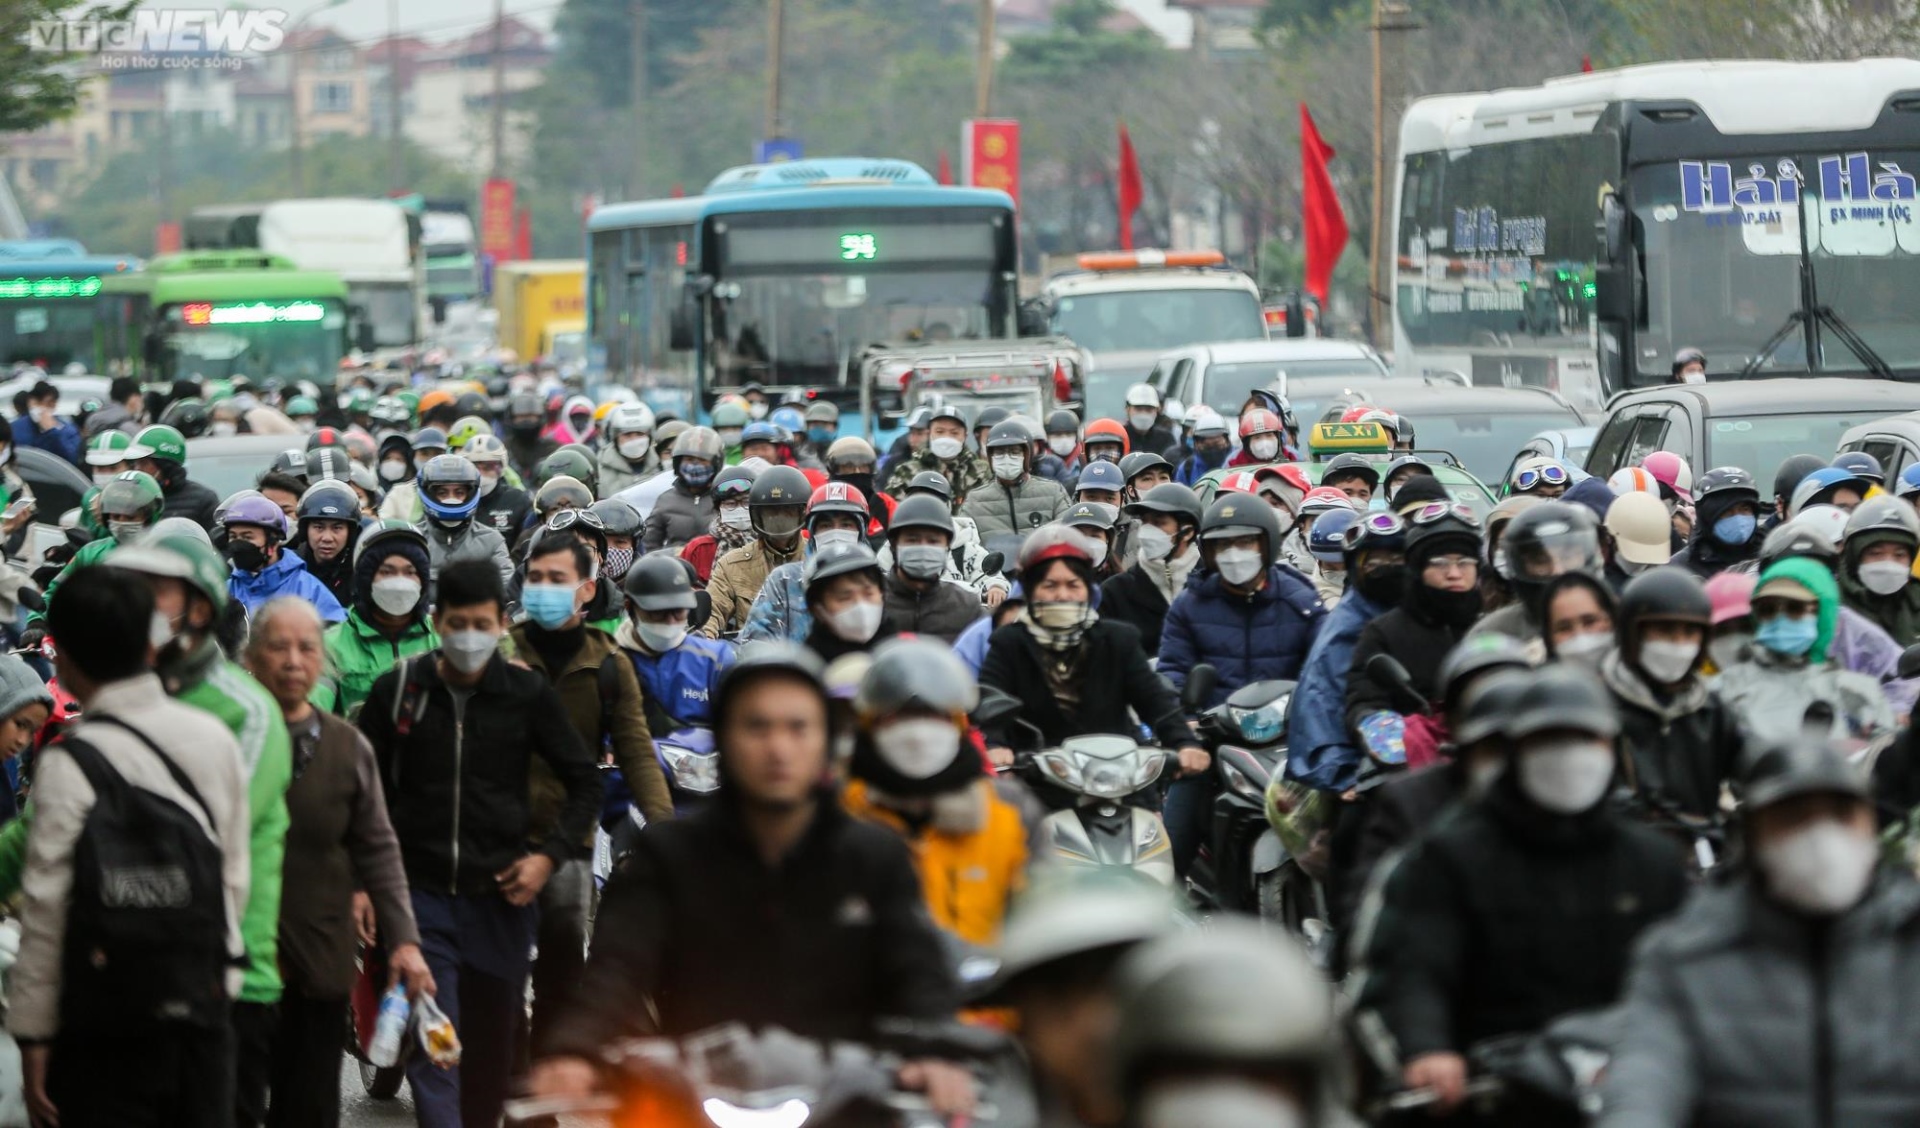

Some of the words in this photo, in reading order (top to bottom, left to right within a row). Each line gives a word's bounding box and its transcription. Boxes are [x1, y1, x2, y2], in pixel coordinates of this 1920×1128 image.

[1679, 157, 1800, 211] Hải
[1818, 152, 1917, 203] Hà
[1851, 206, 1884, 220] MINH
